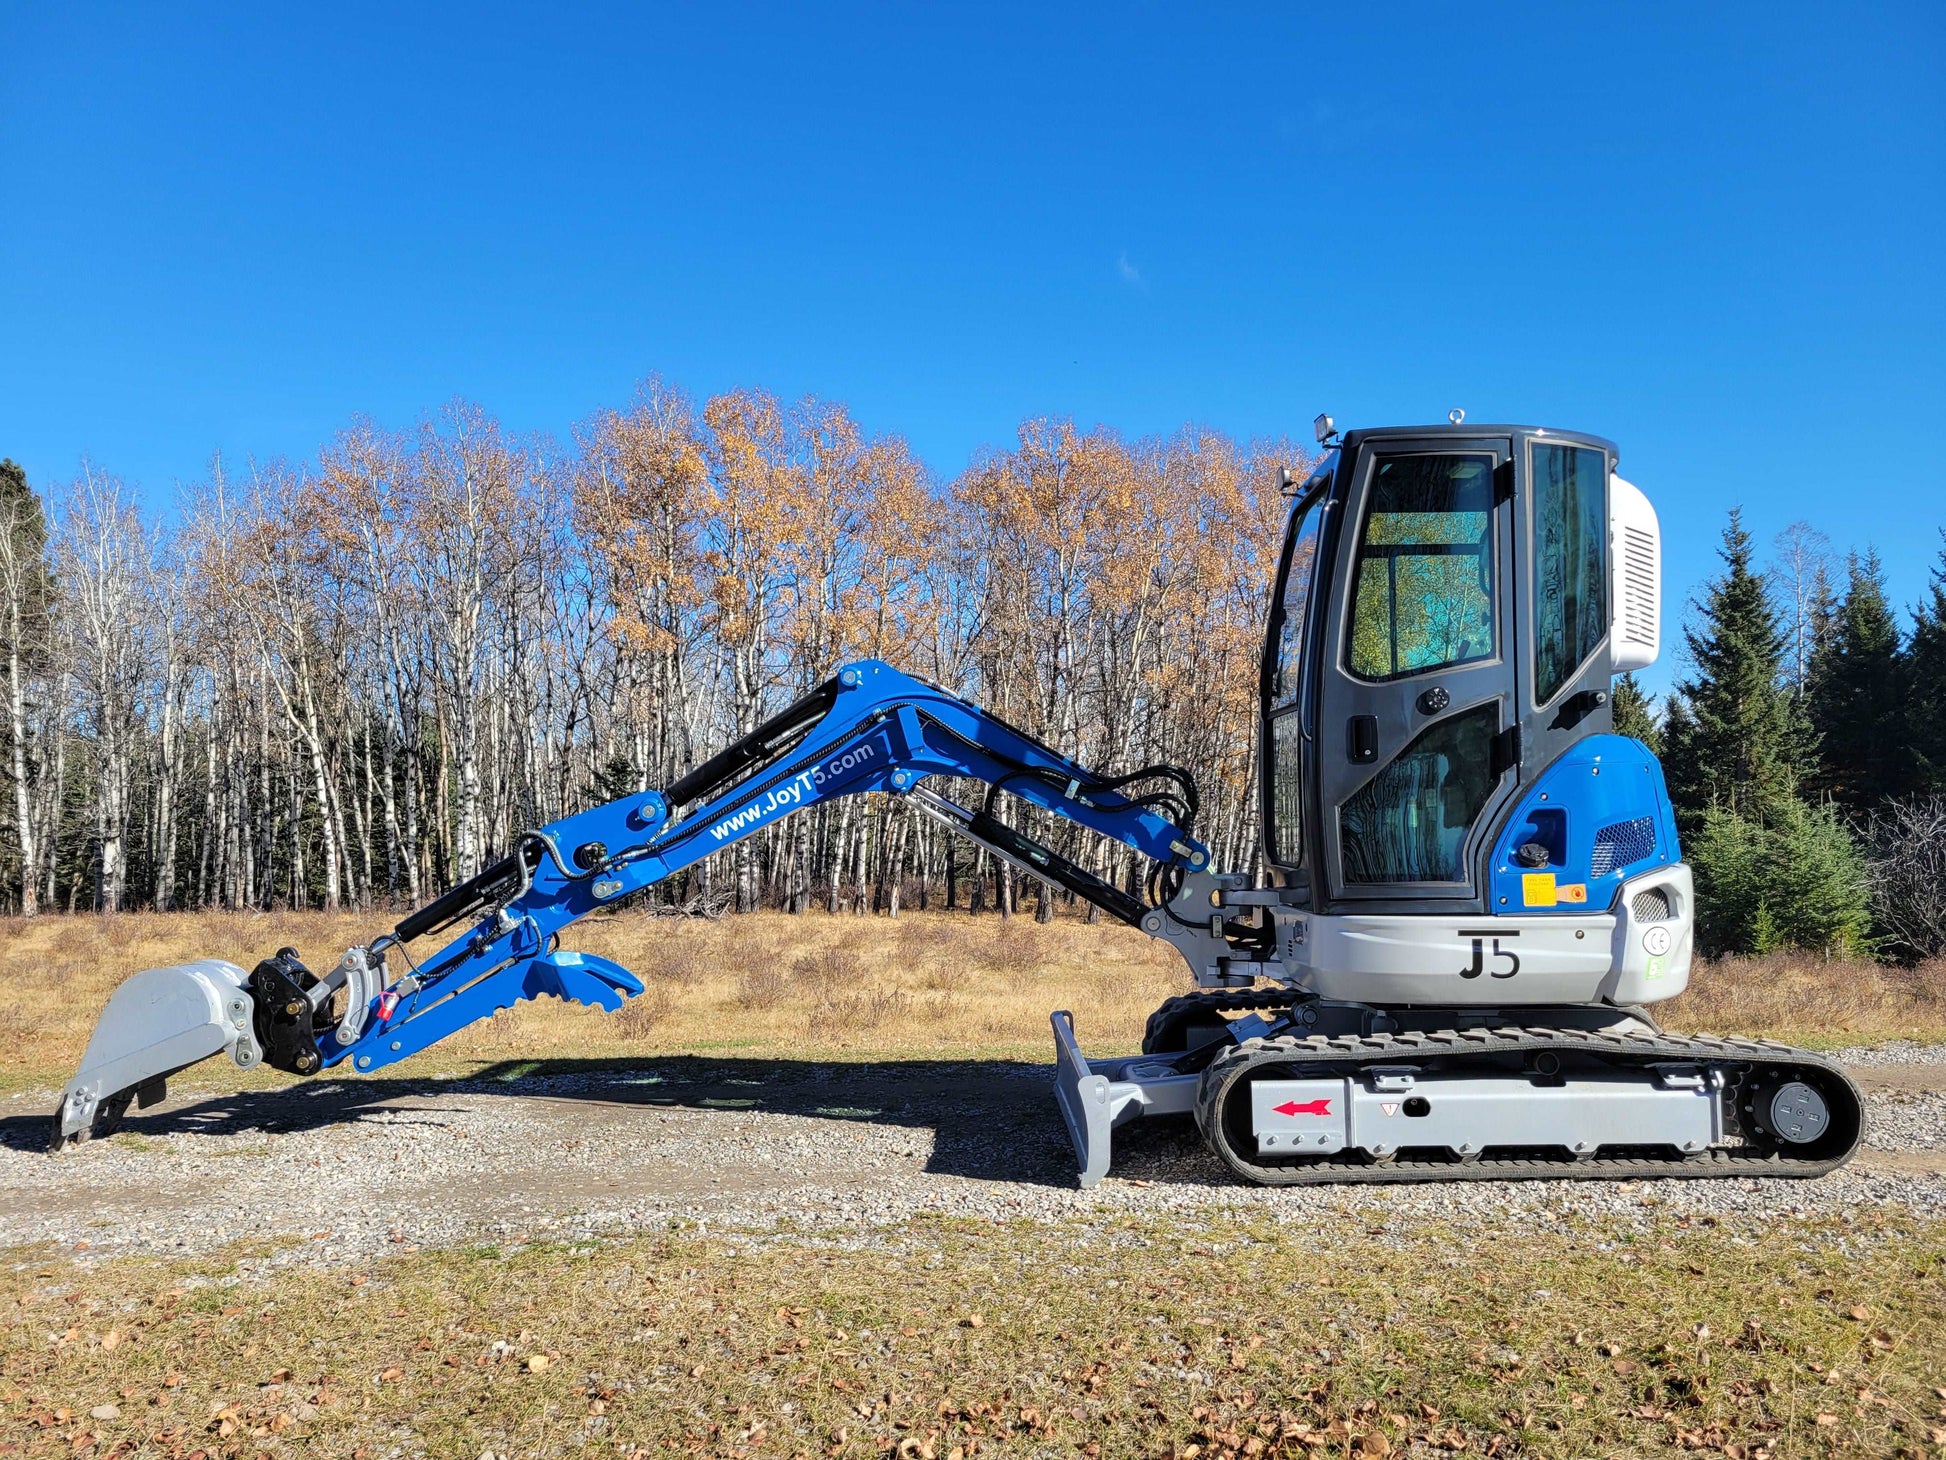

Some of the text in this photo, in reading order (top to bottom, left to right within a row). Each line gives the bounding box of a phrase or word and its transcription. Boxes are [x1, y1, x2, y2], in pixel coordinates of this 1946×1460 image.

[710, 744, 875, 841] www.JoyT5.com
[1458, 930, 1520, 979] J5
[1650, 932, 1665, 950] CE
